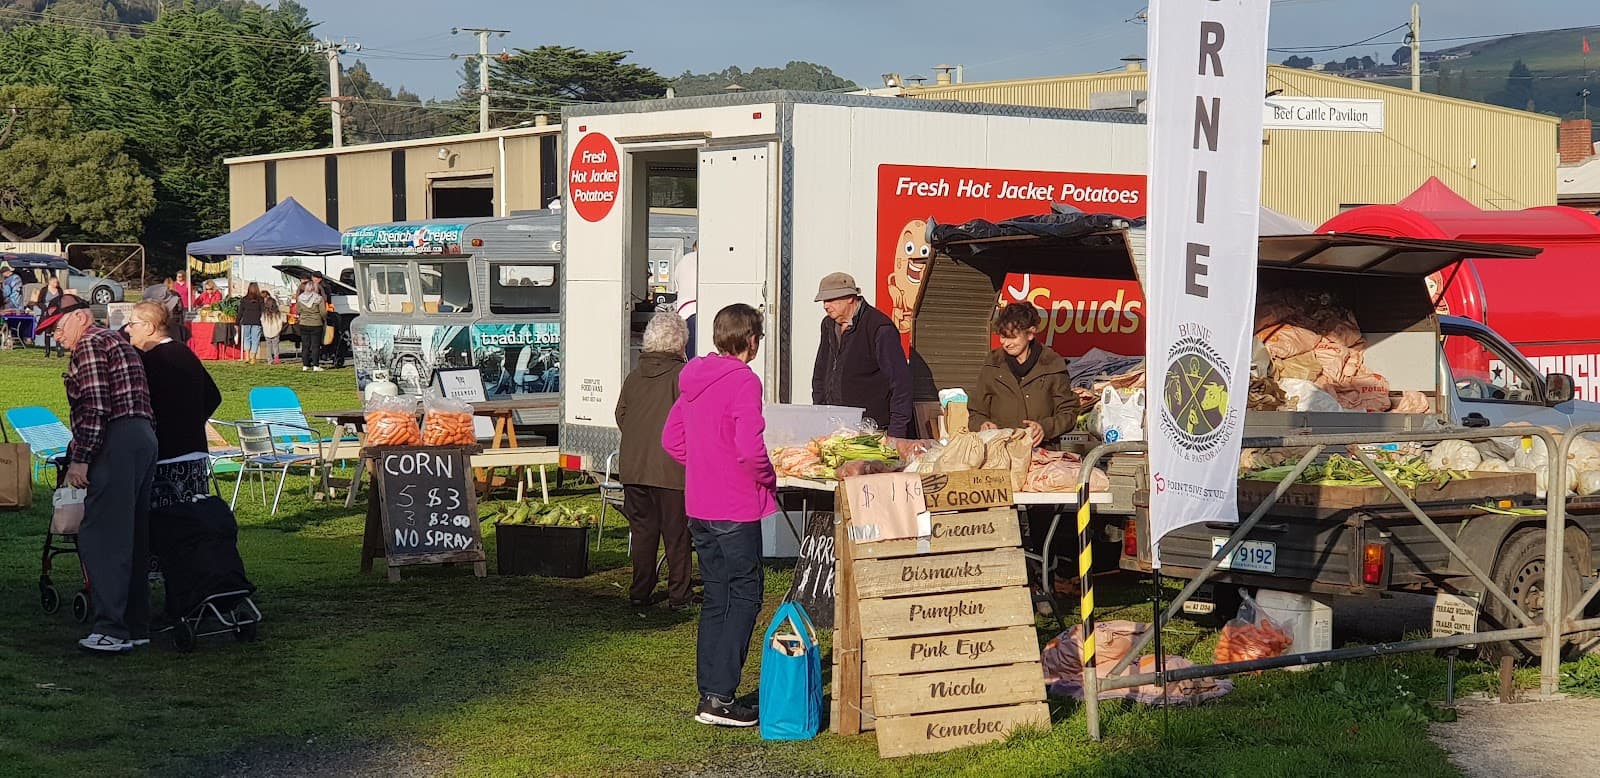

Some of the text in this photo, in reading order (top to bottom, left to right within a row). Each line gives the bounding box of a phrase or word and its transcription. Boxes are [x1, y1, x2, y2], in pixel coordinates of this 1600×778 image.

[1273, 105, 1368, 122] Beef Cattle Pavilion
[582, 150, 607, 164] Fresh
[1185, 20, 1225, 298] RNIE
[571, 169, 618, 183] Hot Jacket
[574, 189, 614, 202] Potatoes
[896, 177, 1139, 204] Fresh Hot Jacket Potatoes
[377, 231, 411, 243] French
[1027, 287, 1142, 346] Spuds
[385, 452, 453, 479] CORN
[396, 483, 417, 508] 5
[946, 489, 1008, 507] GROWN
[403, 510, 416, 527] 3
[395, 528, 473, 550] NO SPRAY
[933, 521, 996, 539] Creams
[1240, 547, 1272, 565] 9192
[901, 561, 983, 582] Bismarks
[909, 600, 985, 624] Pumpkin
[910, 638, 995, 660] Pink Eyes
[929, 677, 987, 699] Nicola
[926, 718, 1003, 740] Kennebec
